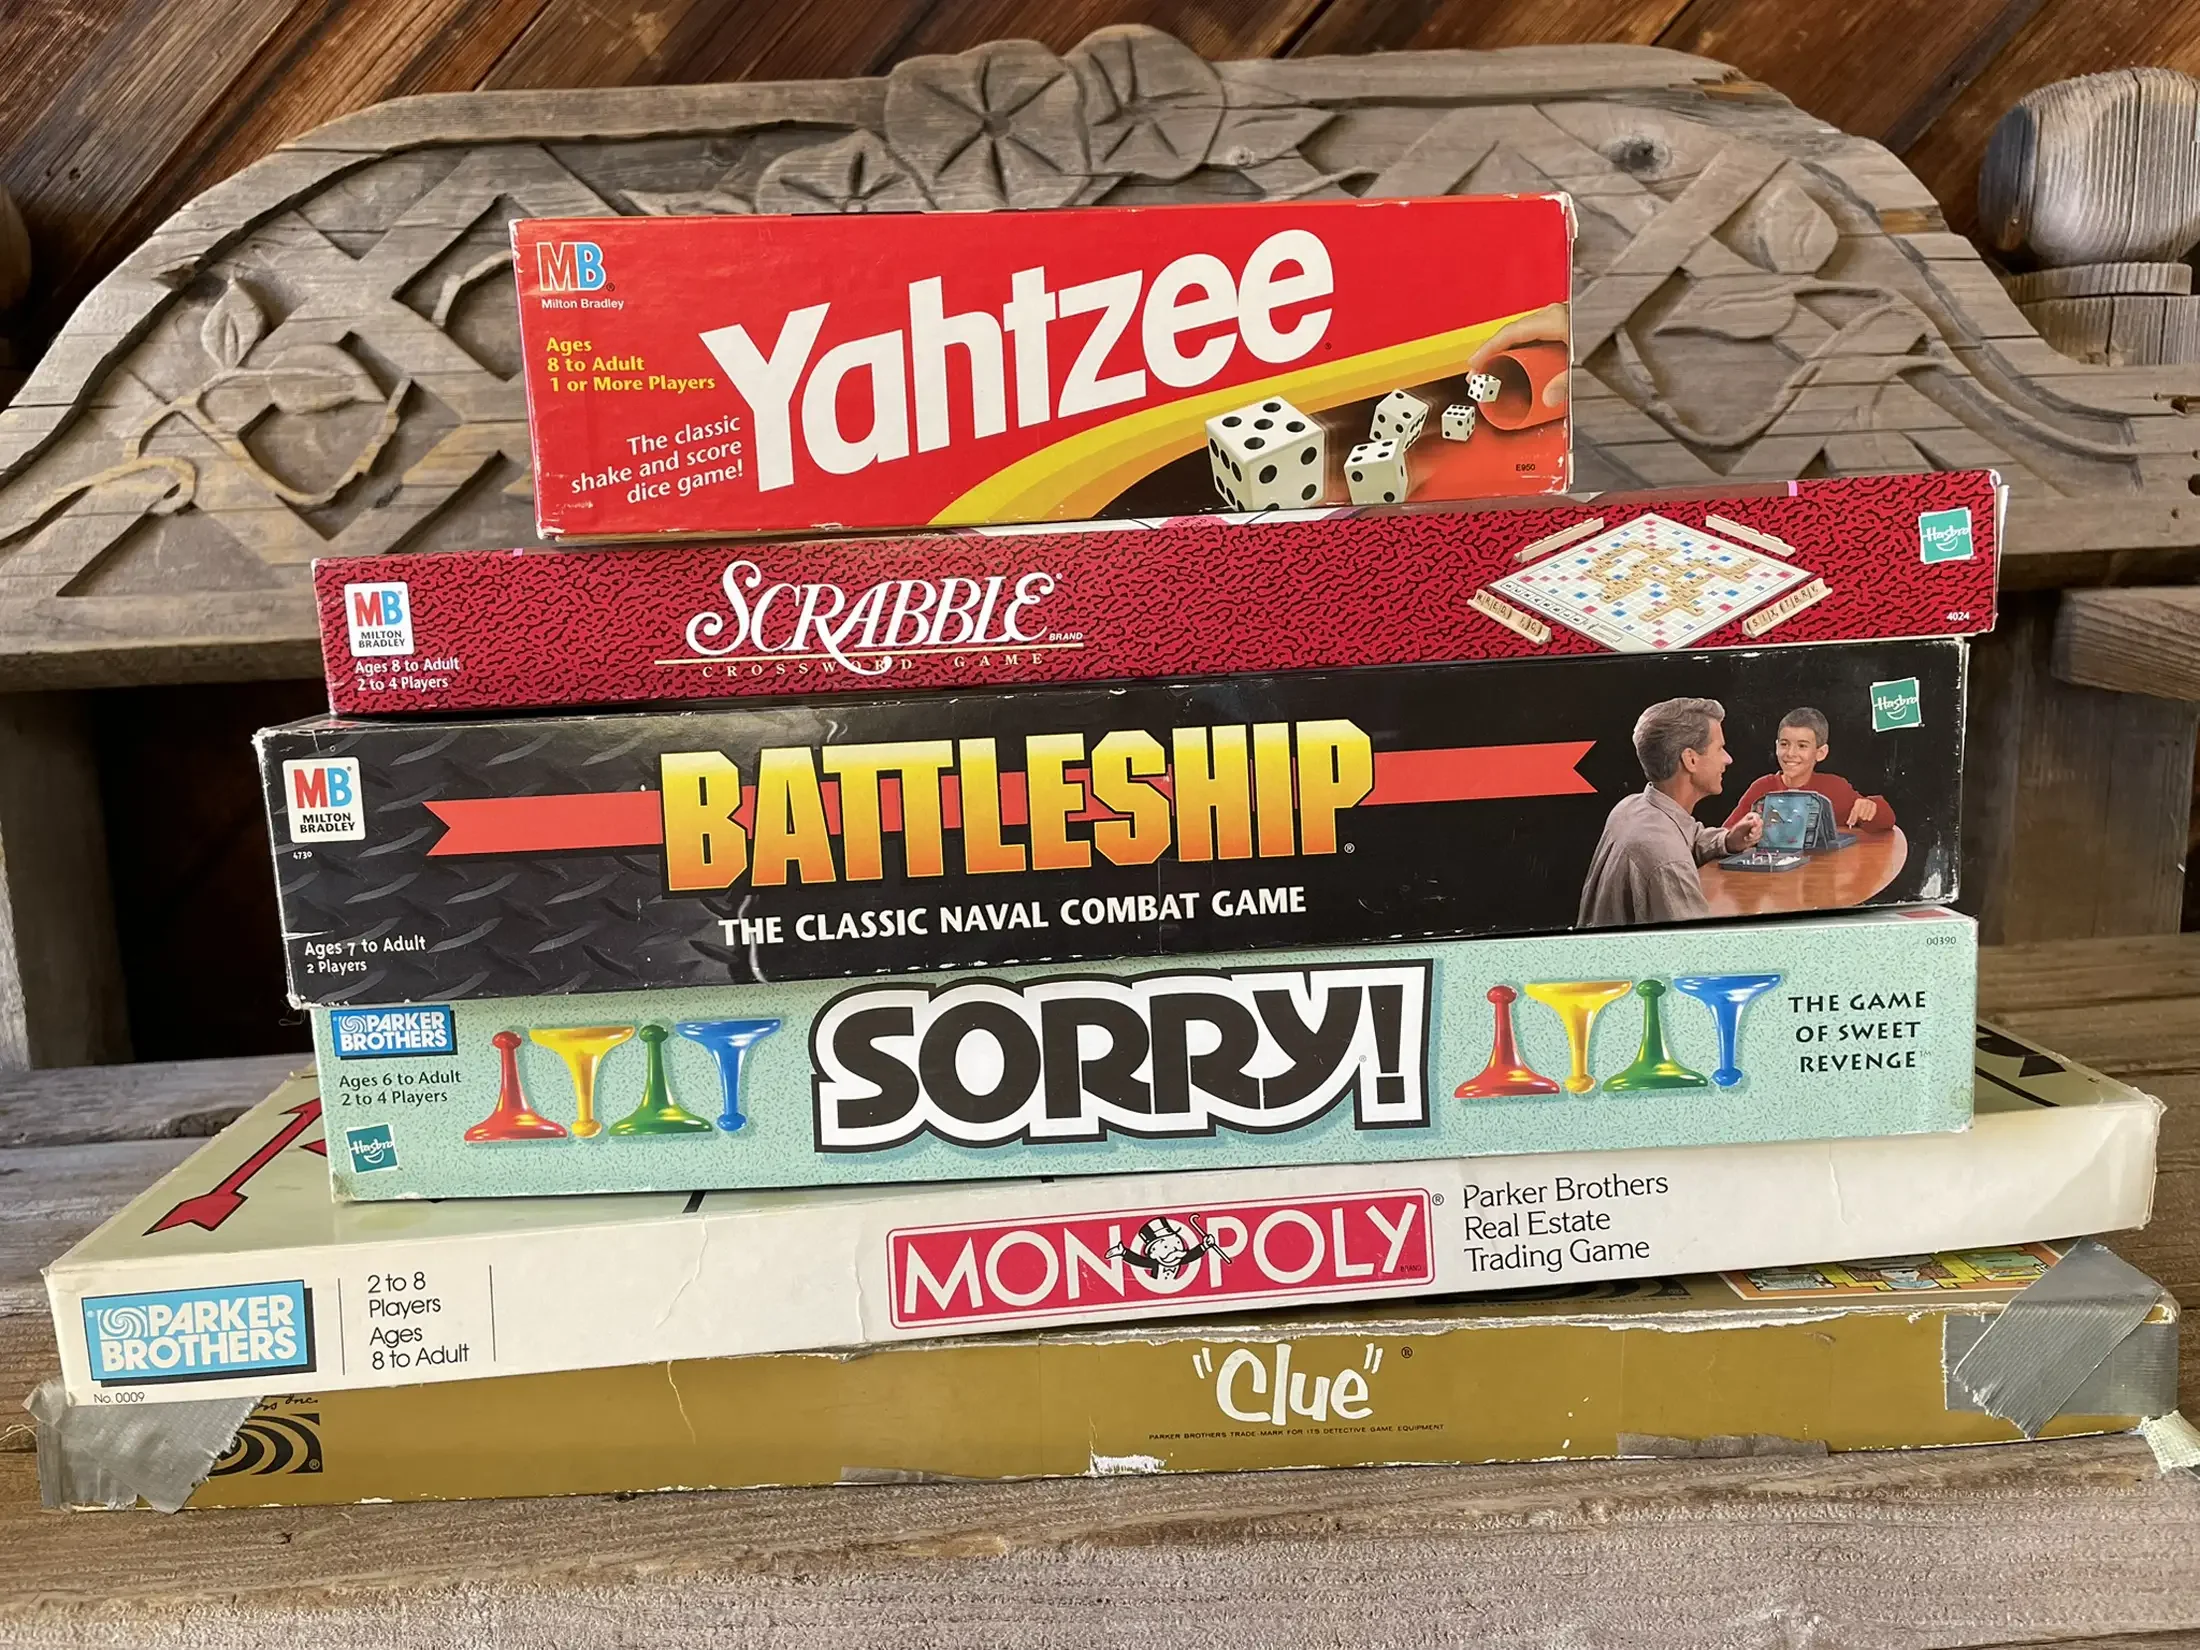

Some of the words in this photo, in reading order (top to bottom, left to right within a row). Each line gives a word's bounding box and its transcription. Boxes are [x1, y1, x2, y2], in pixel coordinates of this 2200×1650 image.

[536, 242, 606, 291] MB
[541, 299, 578, 309] Milton
[581, 299, 624, 310] Bradley
[546, 337, 592, 356] Ages
[547, 357, 560, 372] 8
[565, 359, 586, 372] to
[592, 356, 645, 371] Adult
[699, 229, 1334, 492] Yahtzee
[550, 377, 559, 392] 1
[567, 379, 587, 392] or
[593, 377, 643, 391] More
[648, 375, 715, 394] Players
[627, 434, 668, 456] The
[674, 415, 741, 445] classic
[571, 466, 633, 494] shake
[639, 450, 680, 478] and
[686, 440, 742, 466] score
[1515, 463, 1535, 472] E950
[627, 483, 671, 504] dice
[677, 459, 743, 497] game!
[1924, 525, 1970, 542] Hasbro
[353, 591, 404, 627] MB
[685, 560, 1055, 675] SCRABBLE
[1946, 611, 1970, 621] 4024
[358, 638, 406, 649] BRADLEY
[361, 630, 402, 640] MILTON
[1049, 632, 1083, 642] BRAND
[355, 661, 388, 677] Ages
[391, 659, 401, 672] 8
[404, 658, 419, 671] to
[423, 656, 460, 671] Adult
[702, 658, 913, 678] CROSSWORD
[954, 652, 1043, 668] GAME
[357, 678, 366, 691] 2
[369, 678, 385, 691] to
[388, 677, 397, 690] 4
[401, 675, 449, 692] Players
[1874, 695, 1918, 711] Hasbro
[294, 767, 353, 808] MB
[659, 718, 1374, 891] BATTLESHIP
[300, 822, 356, 834] BRADLEY
[302, 813, 351, 824] MILTON
[292, 851, 313, 860] 4730
[719, 917, 784, 946] THE
[795, 908, 929, 941] CLASSIC
[940, 903, 1049, 935] NAVAL
[1061, 893, 1200, 926] COMBAT
[1211, 887, 1306, 917] GAME
[305, 941, 342, 958] Ages
[347, 943, 355, 956] 7
[361, 940, 378, 953] to
[383, 935, 426, 952] Adult
[1926, 936, 1957, 946] 00390
[307, 964, 314, 974] 2
[318, 959, 367, 976] Players
[1788, 994, 1840, 1013] THE
[1849, 991, 1926, 1011] GAME
[367, 1012, 445, 1033] PARKER
[1796, 1025, 1828, 1042] OF
[1839, 1022, 1921, 1041] SWEET
[340, 1029, 448, 1052] BROTHERS
[822, 968, 1422, 1146] SORRY!
[1800, 1051, 1916, 1073] REVENGE
[339, 1075, 377, 1091] Ages
[383, 1073, 393, 1086] 6
[398, 1073, 414, 1085] to
[419, 1070, 461, 1084] Adult
[342, 1093, 351, 1106] 2
[356, 1094, 372, 1105] to
[377, 1092, 386, 1104] 4
[392, 1091, 448, 1107] Players
[351, 1138, 394, 1154] Hasbro
[1463, 1181, 1548, 1209] Parker
[1555, 1173, 1669, 1202] Brothers
[1464, 1213, 1519, 1240] Real
[1527, 1210, 1611, 1236] Estate
[904, 1202, 1418, 1314] MONOPOLY
[1464, 1244, 1563, 1272] Trading
[1569, 1239, 1650, 1263] Game
[368, 1274, 381, 1293] 2
[385, 1274, 407, 1292] to
[413, 1271, 426, 1290] 8
[149, 1294, 295, 1337] PARKER
[369, 1298, 441, 1319] Players
[369, 1327, 423, 1348] Ages
[101, 1326, 297, 1372] BROTHERS
[372, 1351, 385, 1370] 8
[389, 1350, 411, 1368] to
[415, 1343, 470, 1367] Adult
[94, 1393, 113, 1404] No.
[115, 1392, 145, 1404] 0009
[1398, 1424, 1445, 1432] EQUIPMENT
